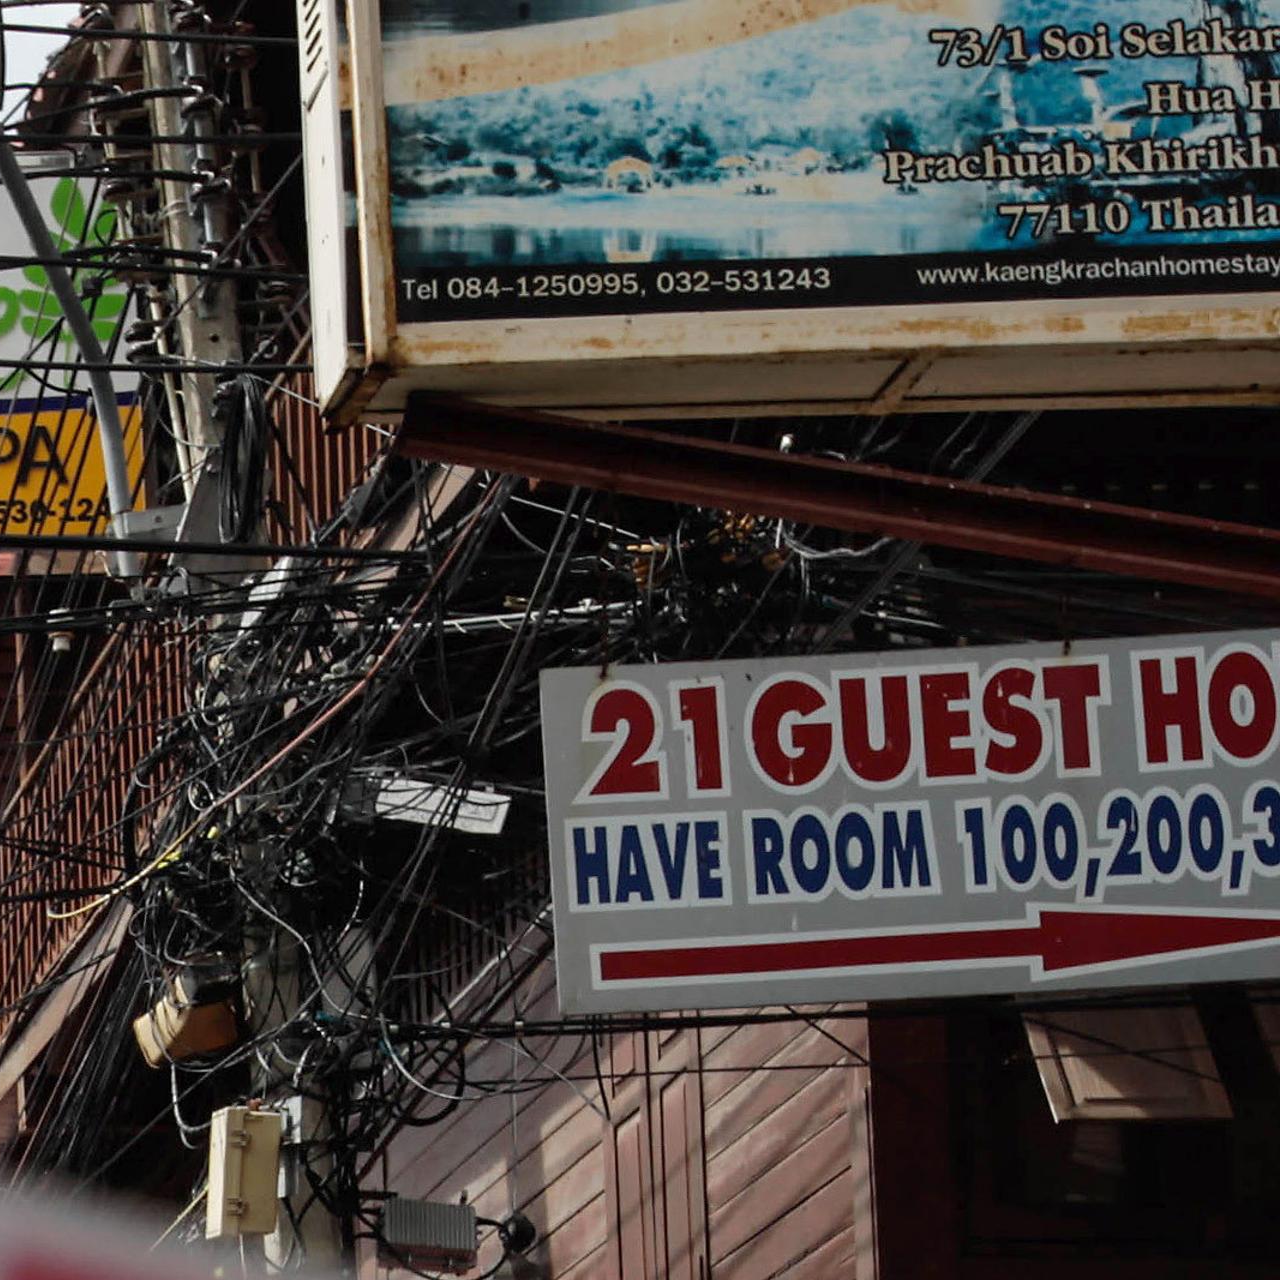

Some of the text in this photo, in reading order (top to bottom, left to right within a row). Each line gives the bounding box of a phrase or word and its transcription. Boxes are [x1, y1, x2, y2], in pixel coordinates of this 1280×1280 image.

[930, 25, 1030, 68] 73/1
[1042, 26, 1112, 60] Soi
[1146, 81, 1237, 114] Hua
[885, 136, 1280, 183] Prachuab Khirikh
[999, 195, 1280, 238] 77110 Thaila
[402, 268, 831, 299] Tel 084-1250995, 032-531243
[589, 650, 1278, 796] 21 GUEST HO
[572, 820, 724, 905] HAVE
[751, 809, 931, 896] ROOM
